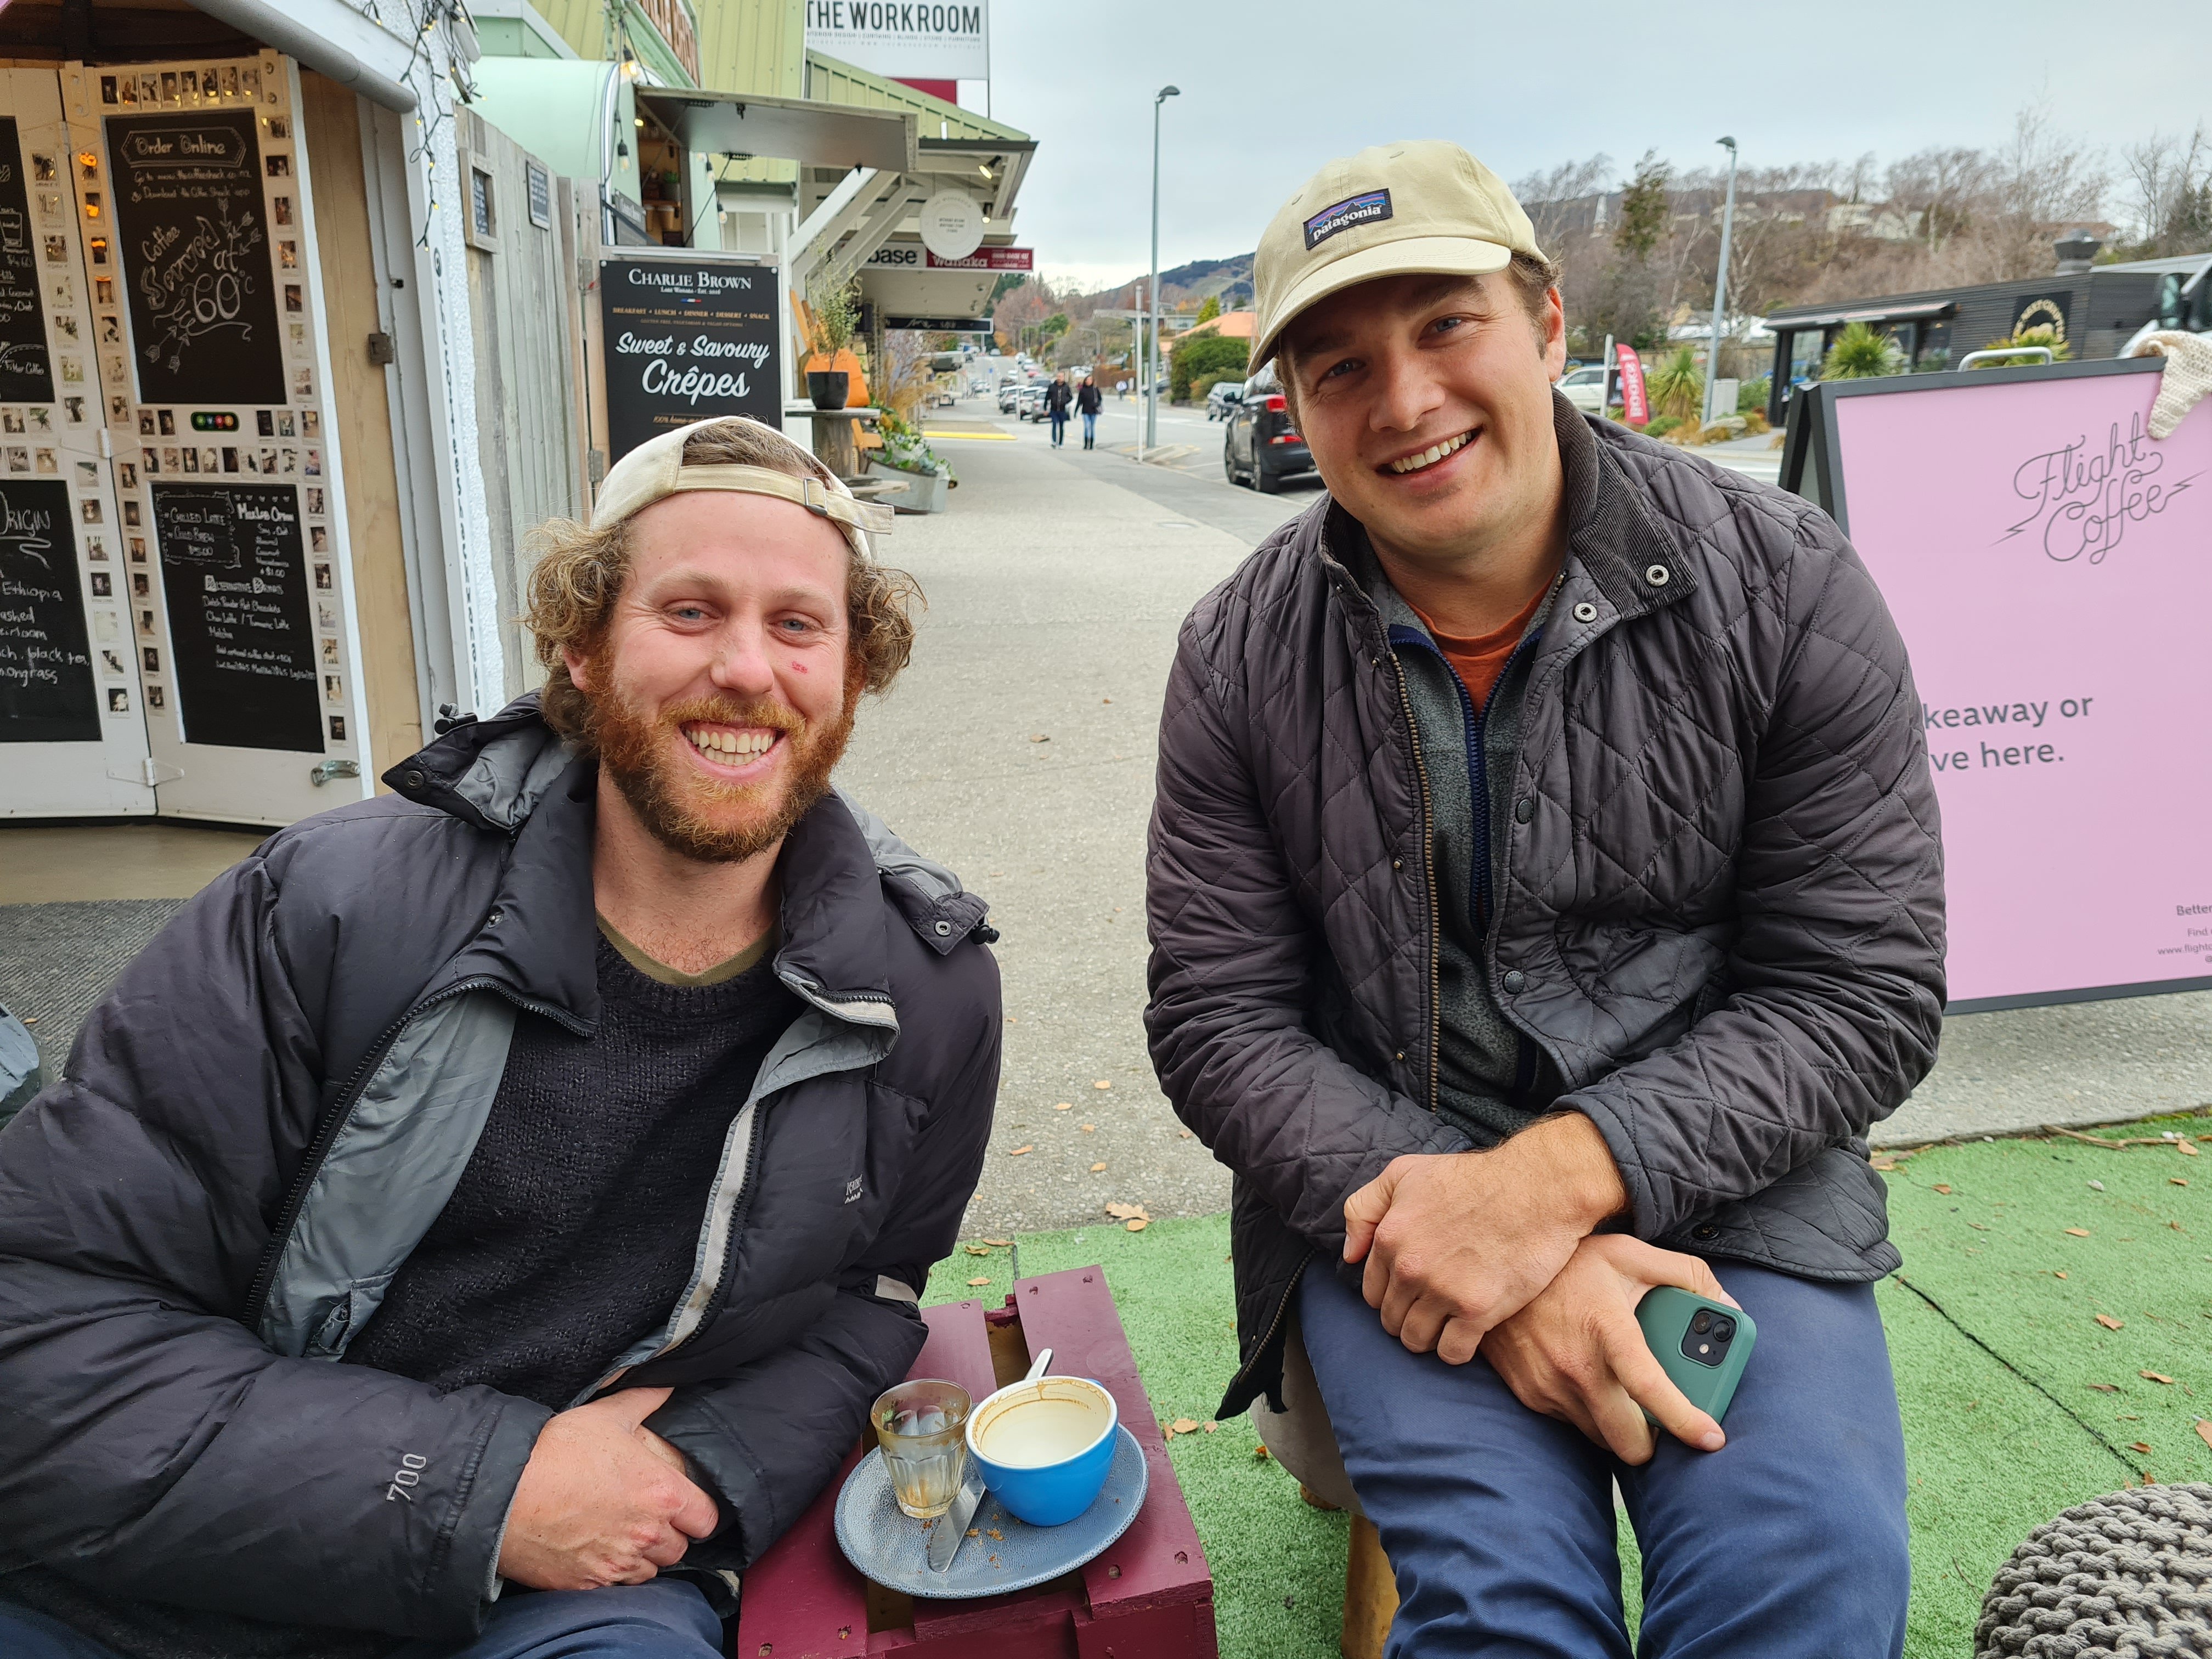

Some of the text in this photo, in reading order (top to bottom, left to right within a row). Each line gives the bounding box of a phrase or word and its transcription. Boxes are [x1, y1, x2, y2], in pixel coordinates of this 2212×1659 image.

[807, 1, 981, 34] THE WORKROOM
[136, 133, 226, 156] Order Online
[1312, 205, 1383, 241] patagonia
[142, 225, 180, 262] Coffee
[213, 232, 239, 273] at
[628, 268, 752, 290] CHARLIE BROWN
[613, 307, 646, 315] BREAKFAST
[654, 308, 677, 317] LUNCH
[684, 309, 709, 318] DINNER
[715, 311, 742, 319] DESSERT
[615, 331, 771, 369] Sweet & Savoury
[642, 358, 751, 406] Crêpes
[2012, 411, 2146, 516] Flight
[2044, 454, 2167, 565] Coffee
[2, 580, 63, 603] Ethiopia
[2060, 697, 2094, 718] or
[1980, 741, 2064, 768] here.
[2187, 927, 2208, 936] Find
[386, 1453, 427, 1502] 700
